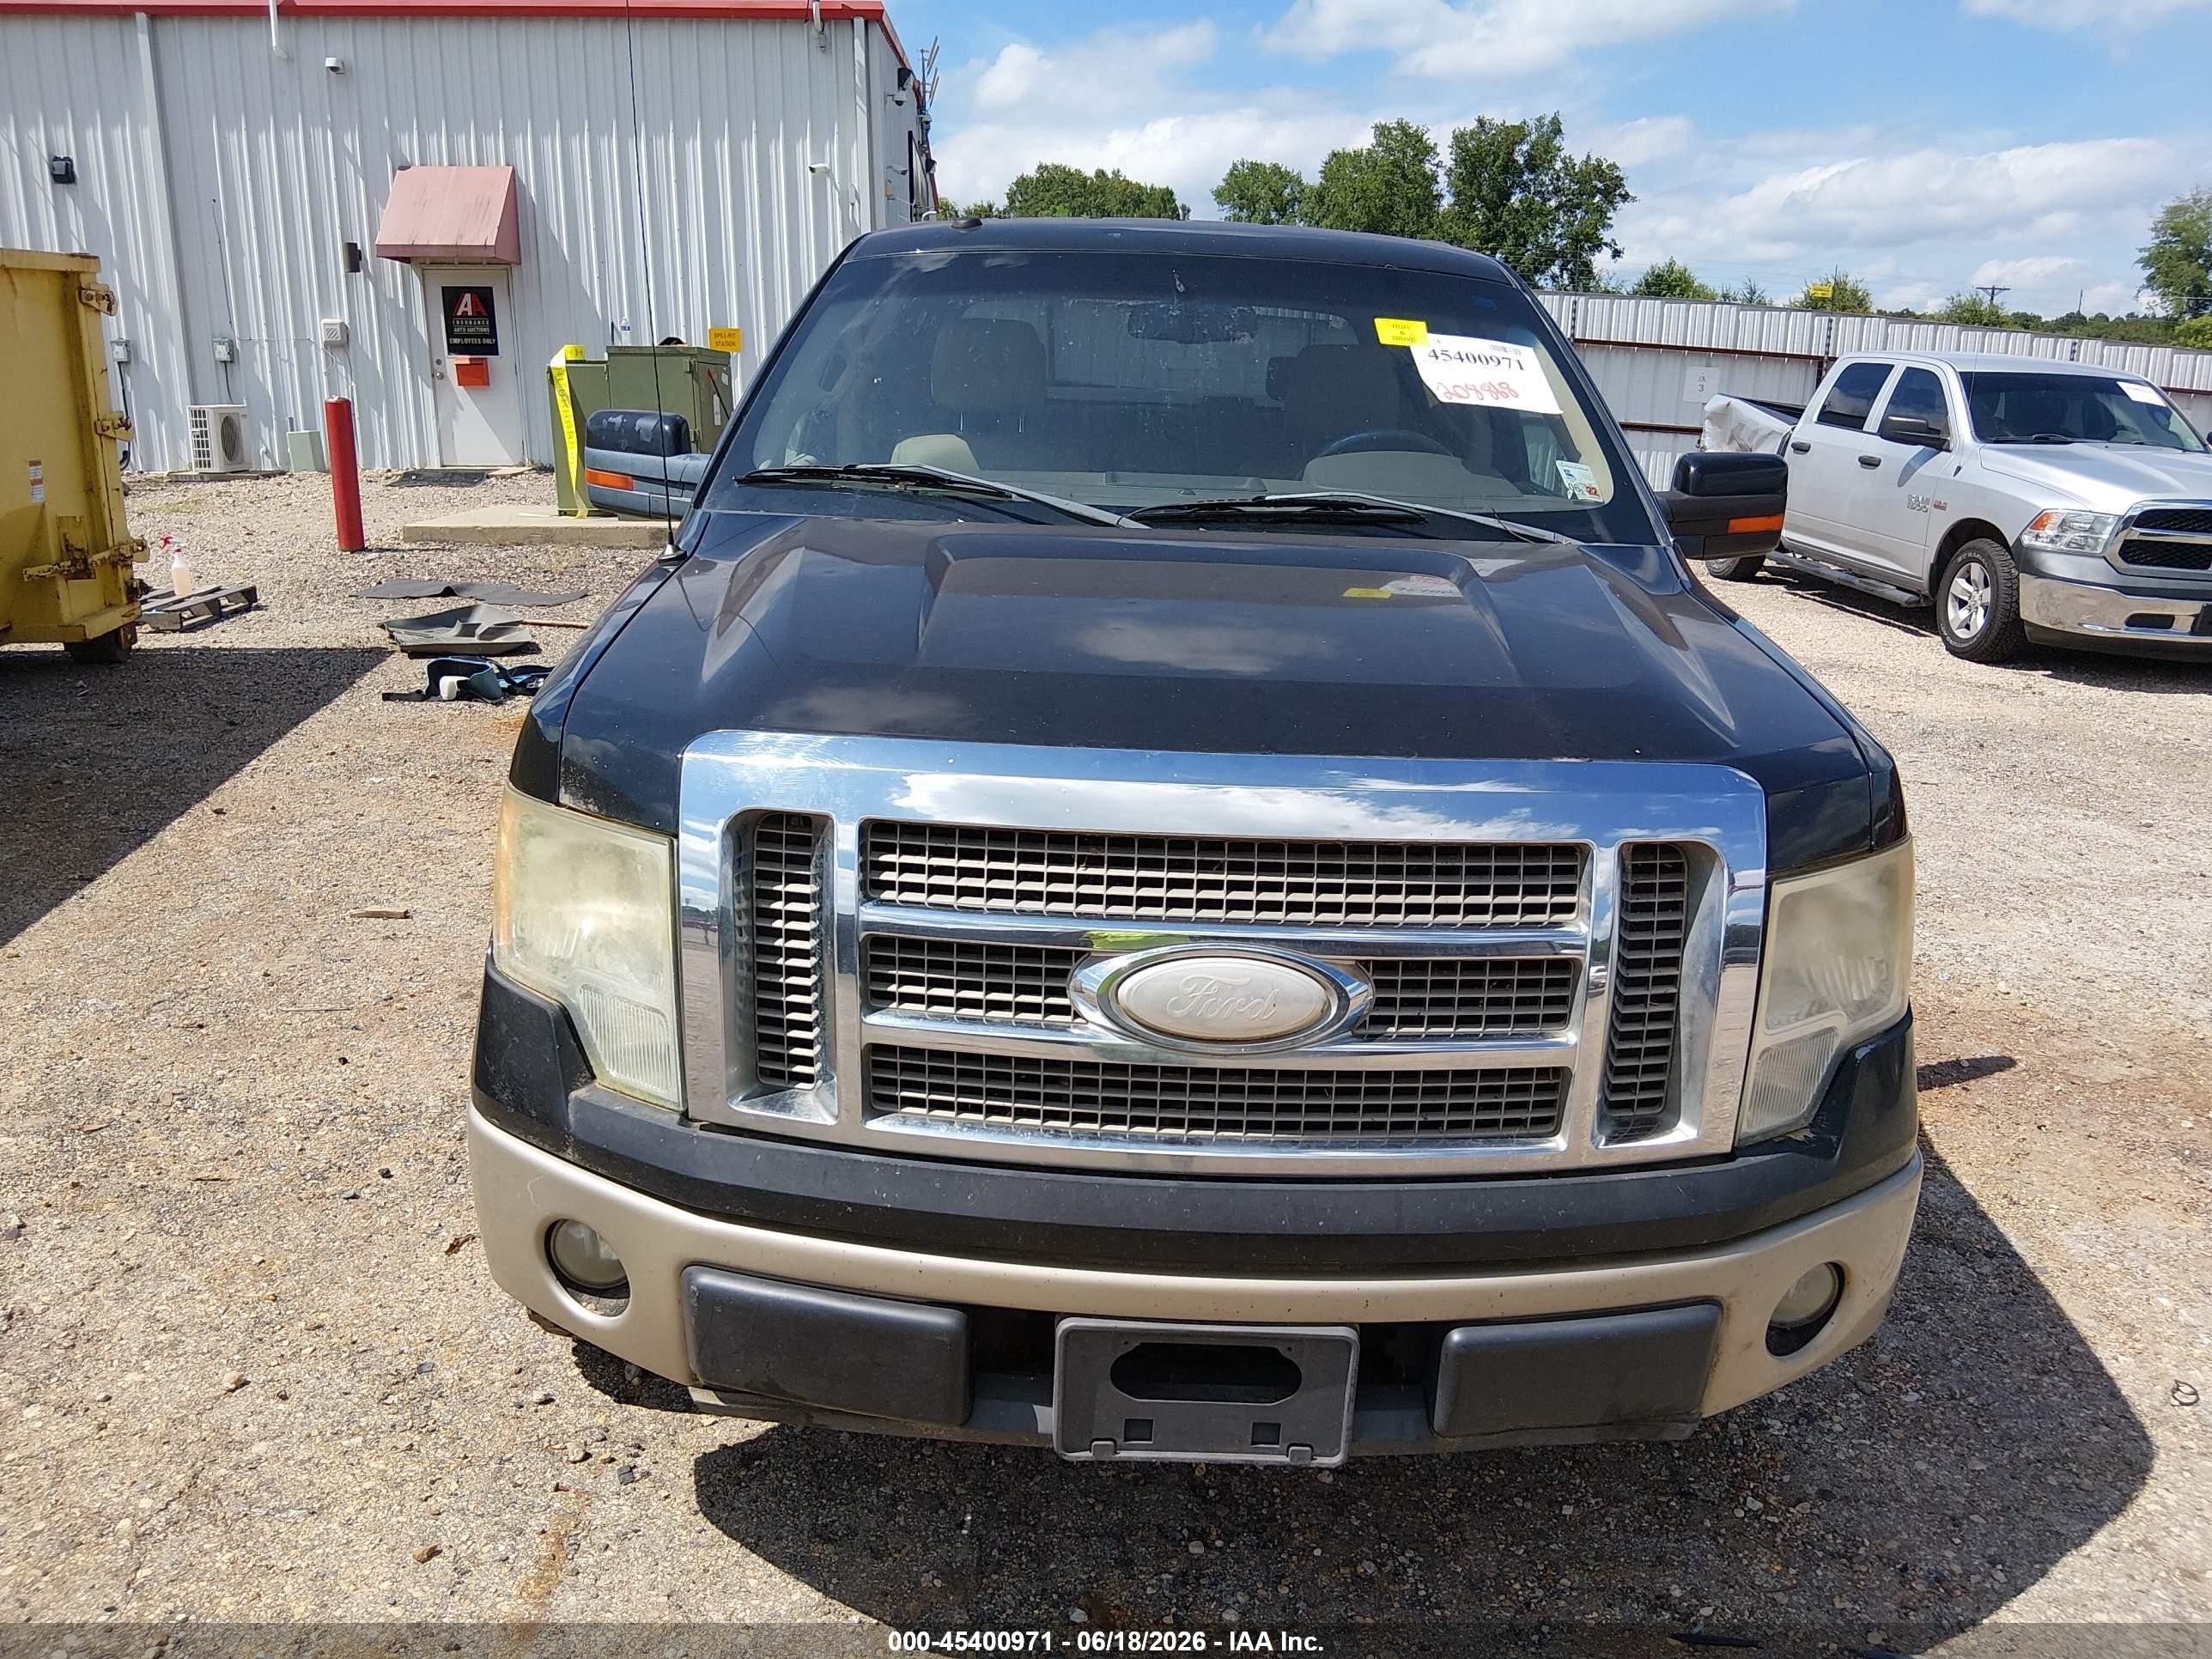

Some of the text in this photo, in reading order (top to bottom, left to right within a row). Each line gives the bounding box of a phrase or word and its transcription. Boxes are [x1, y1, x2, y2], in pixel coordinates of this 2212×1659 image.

[1427, 348, 1525, 371] 45400971
[1585, 486, 1599, 496] 22
[1166, 974, 1279, 1020] Ford
